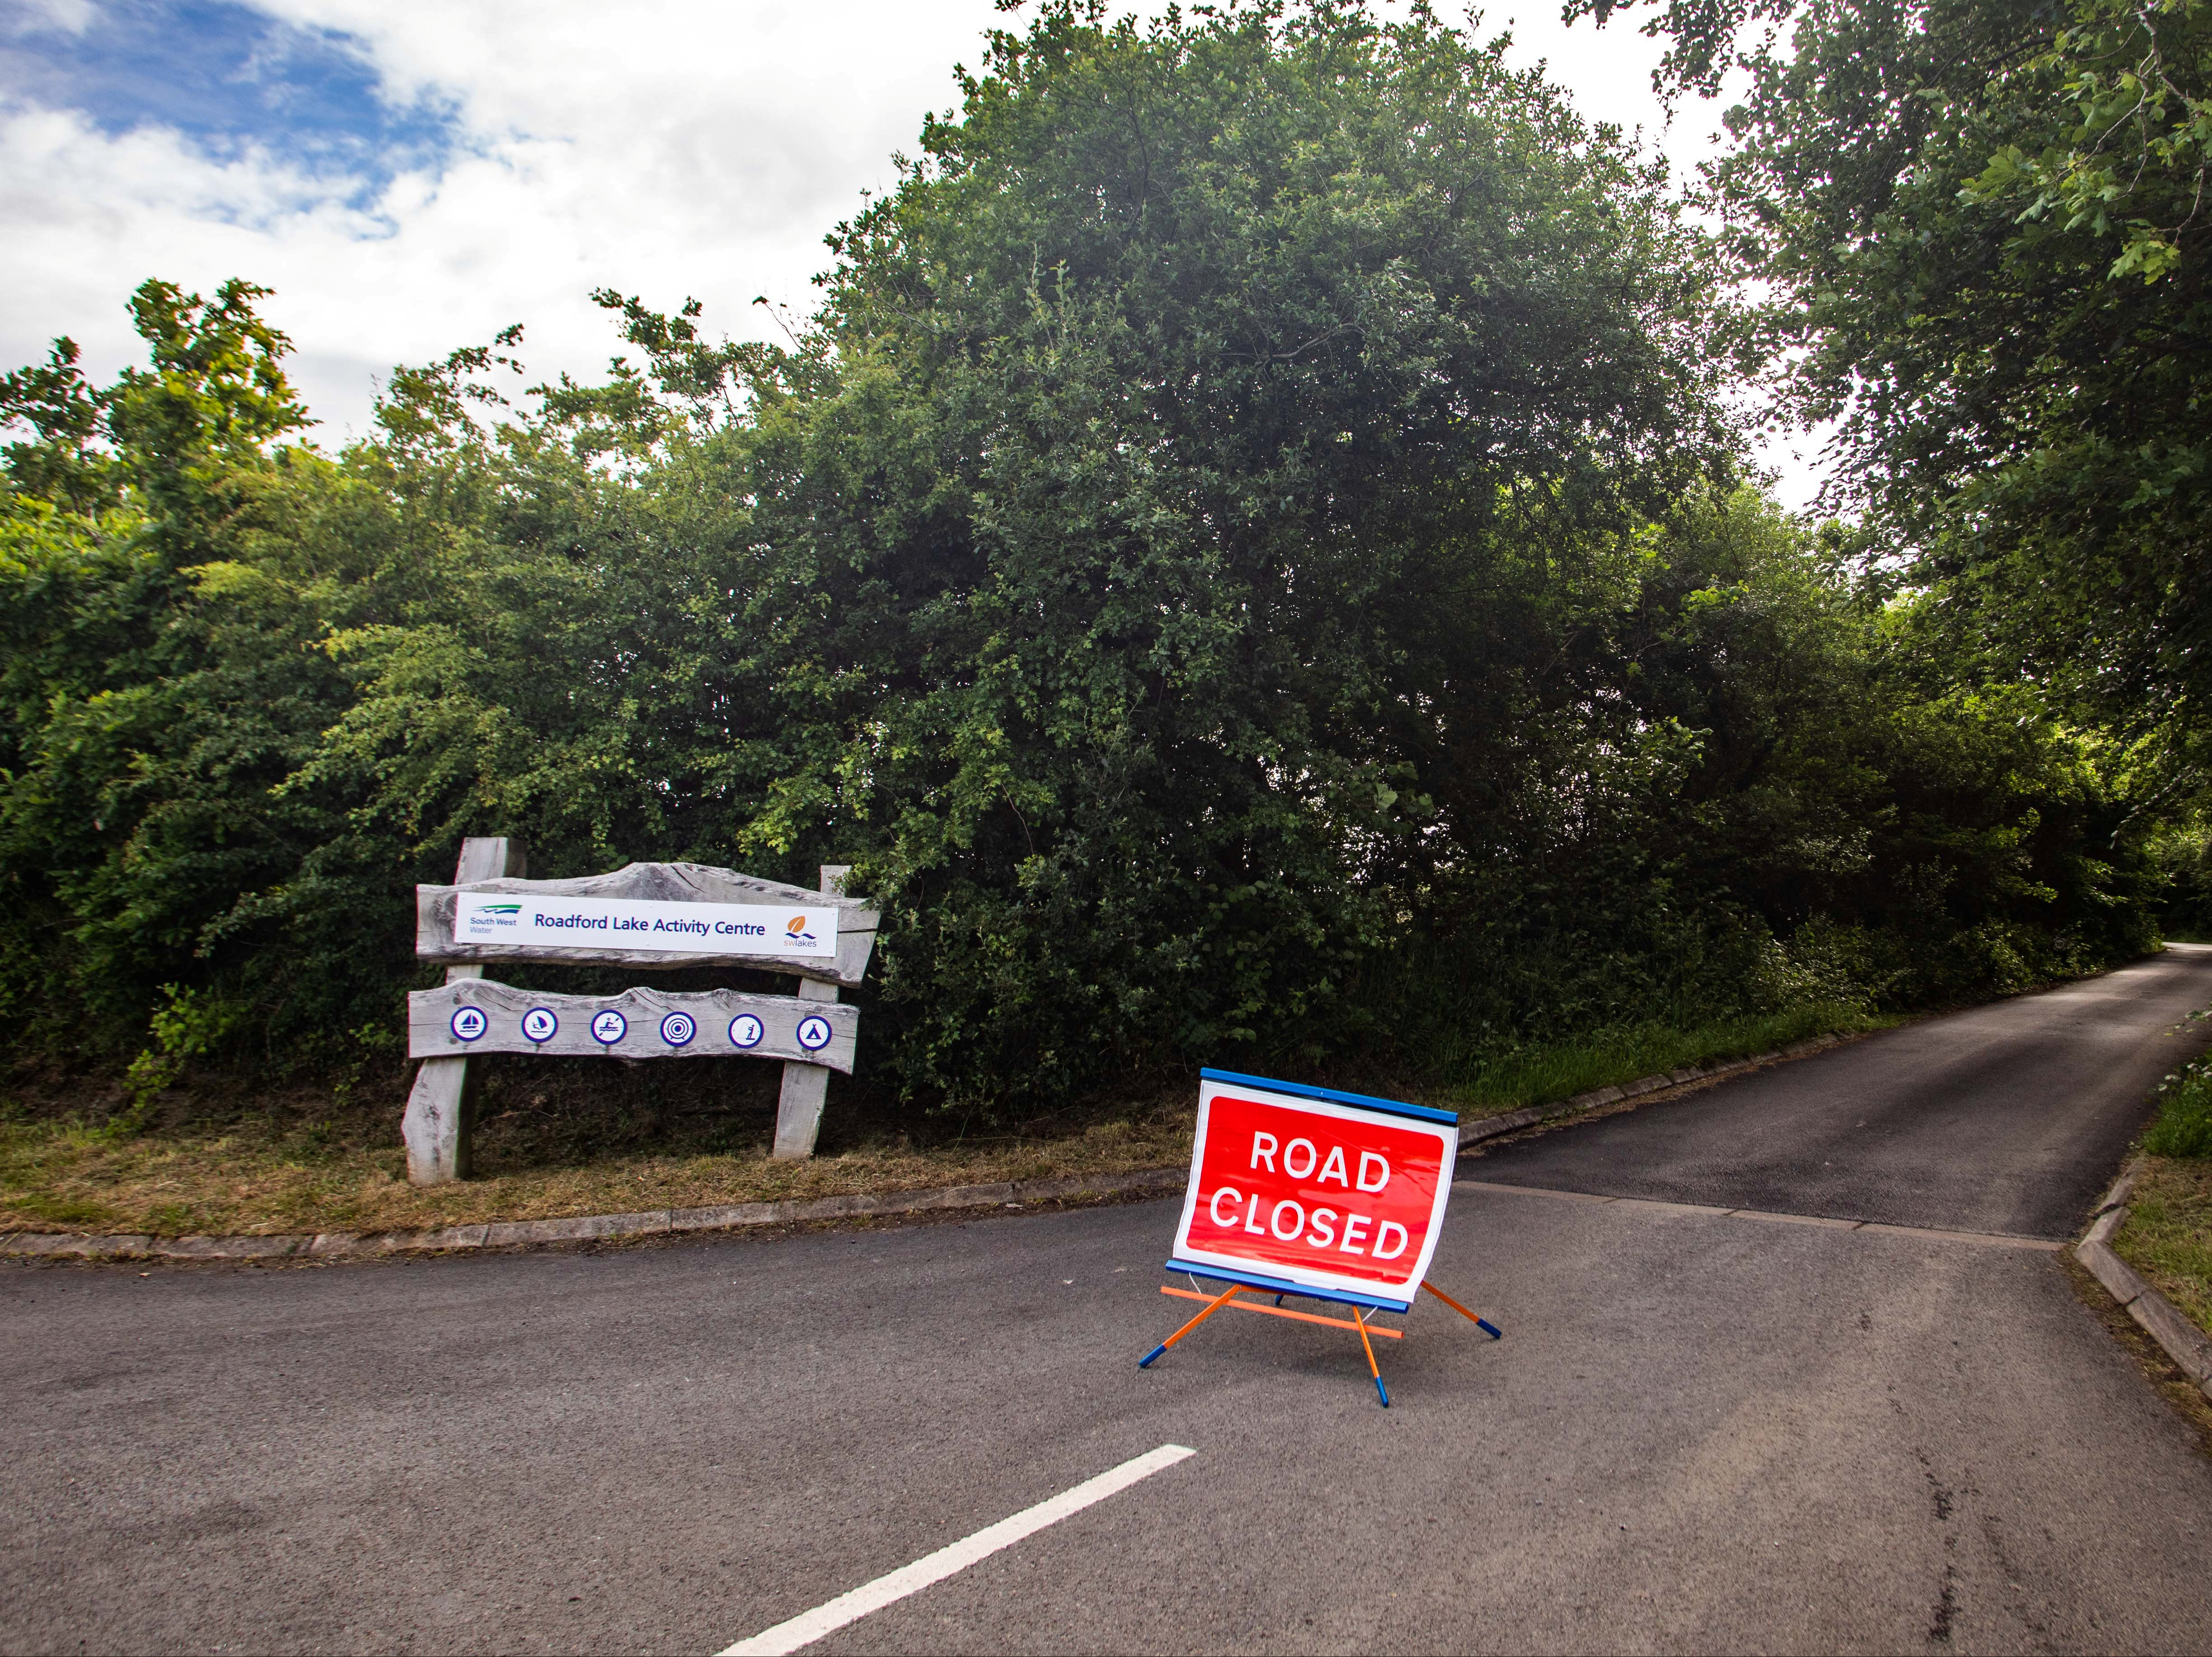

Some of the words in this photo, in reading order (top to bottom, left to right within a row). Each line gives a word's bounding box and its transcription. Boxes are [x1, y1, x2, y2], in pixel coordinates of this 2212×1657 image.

[470, 917, 494, 925] South
[535, 914, 607, 929] Roadford
[613, 917, 649, 931] Lake
[653, 919, 710, 936] Activity
[715, 921, 765, 935] Centre
[784, 939, 817, 947] swlakes
[1250, 1131, 1390, 1193] ROAD
[1210, 1187, 1408, 1260] CLOSED
